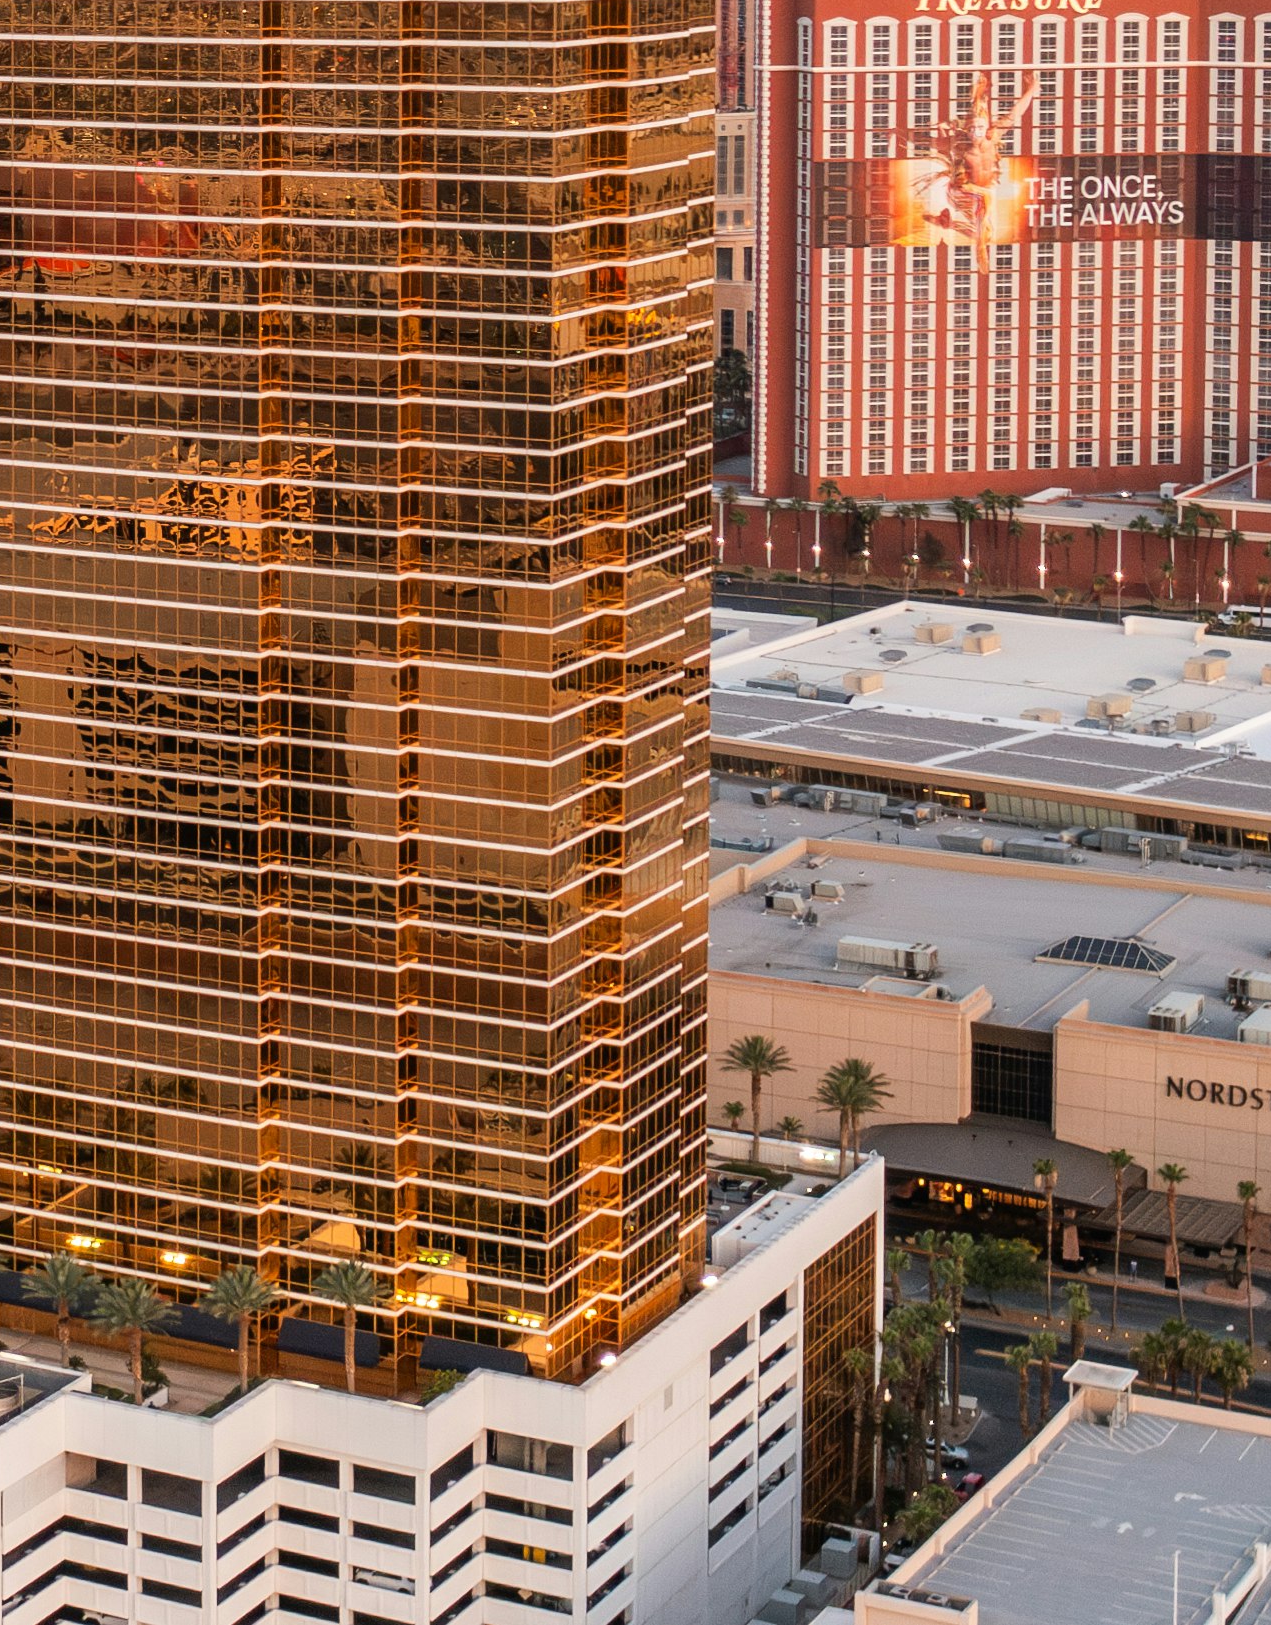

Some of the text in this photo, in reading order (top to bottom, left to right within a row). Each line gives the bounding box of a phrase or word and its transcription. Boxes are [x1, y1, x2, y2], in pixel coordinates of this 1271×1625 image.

[1024, 175, 1164, 200] THE ONCE,
[1024, 201, 1184, 226] THE ALWAYS
